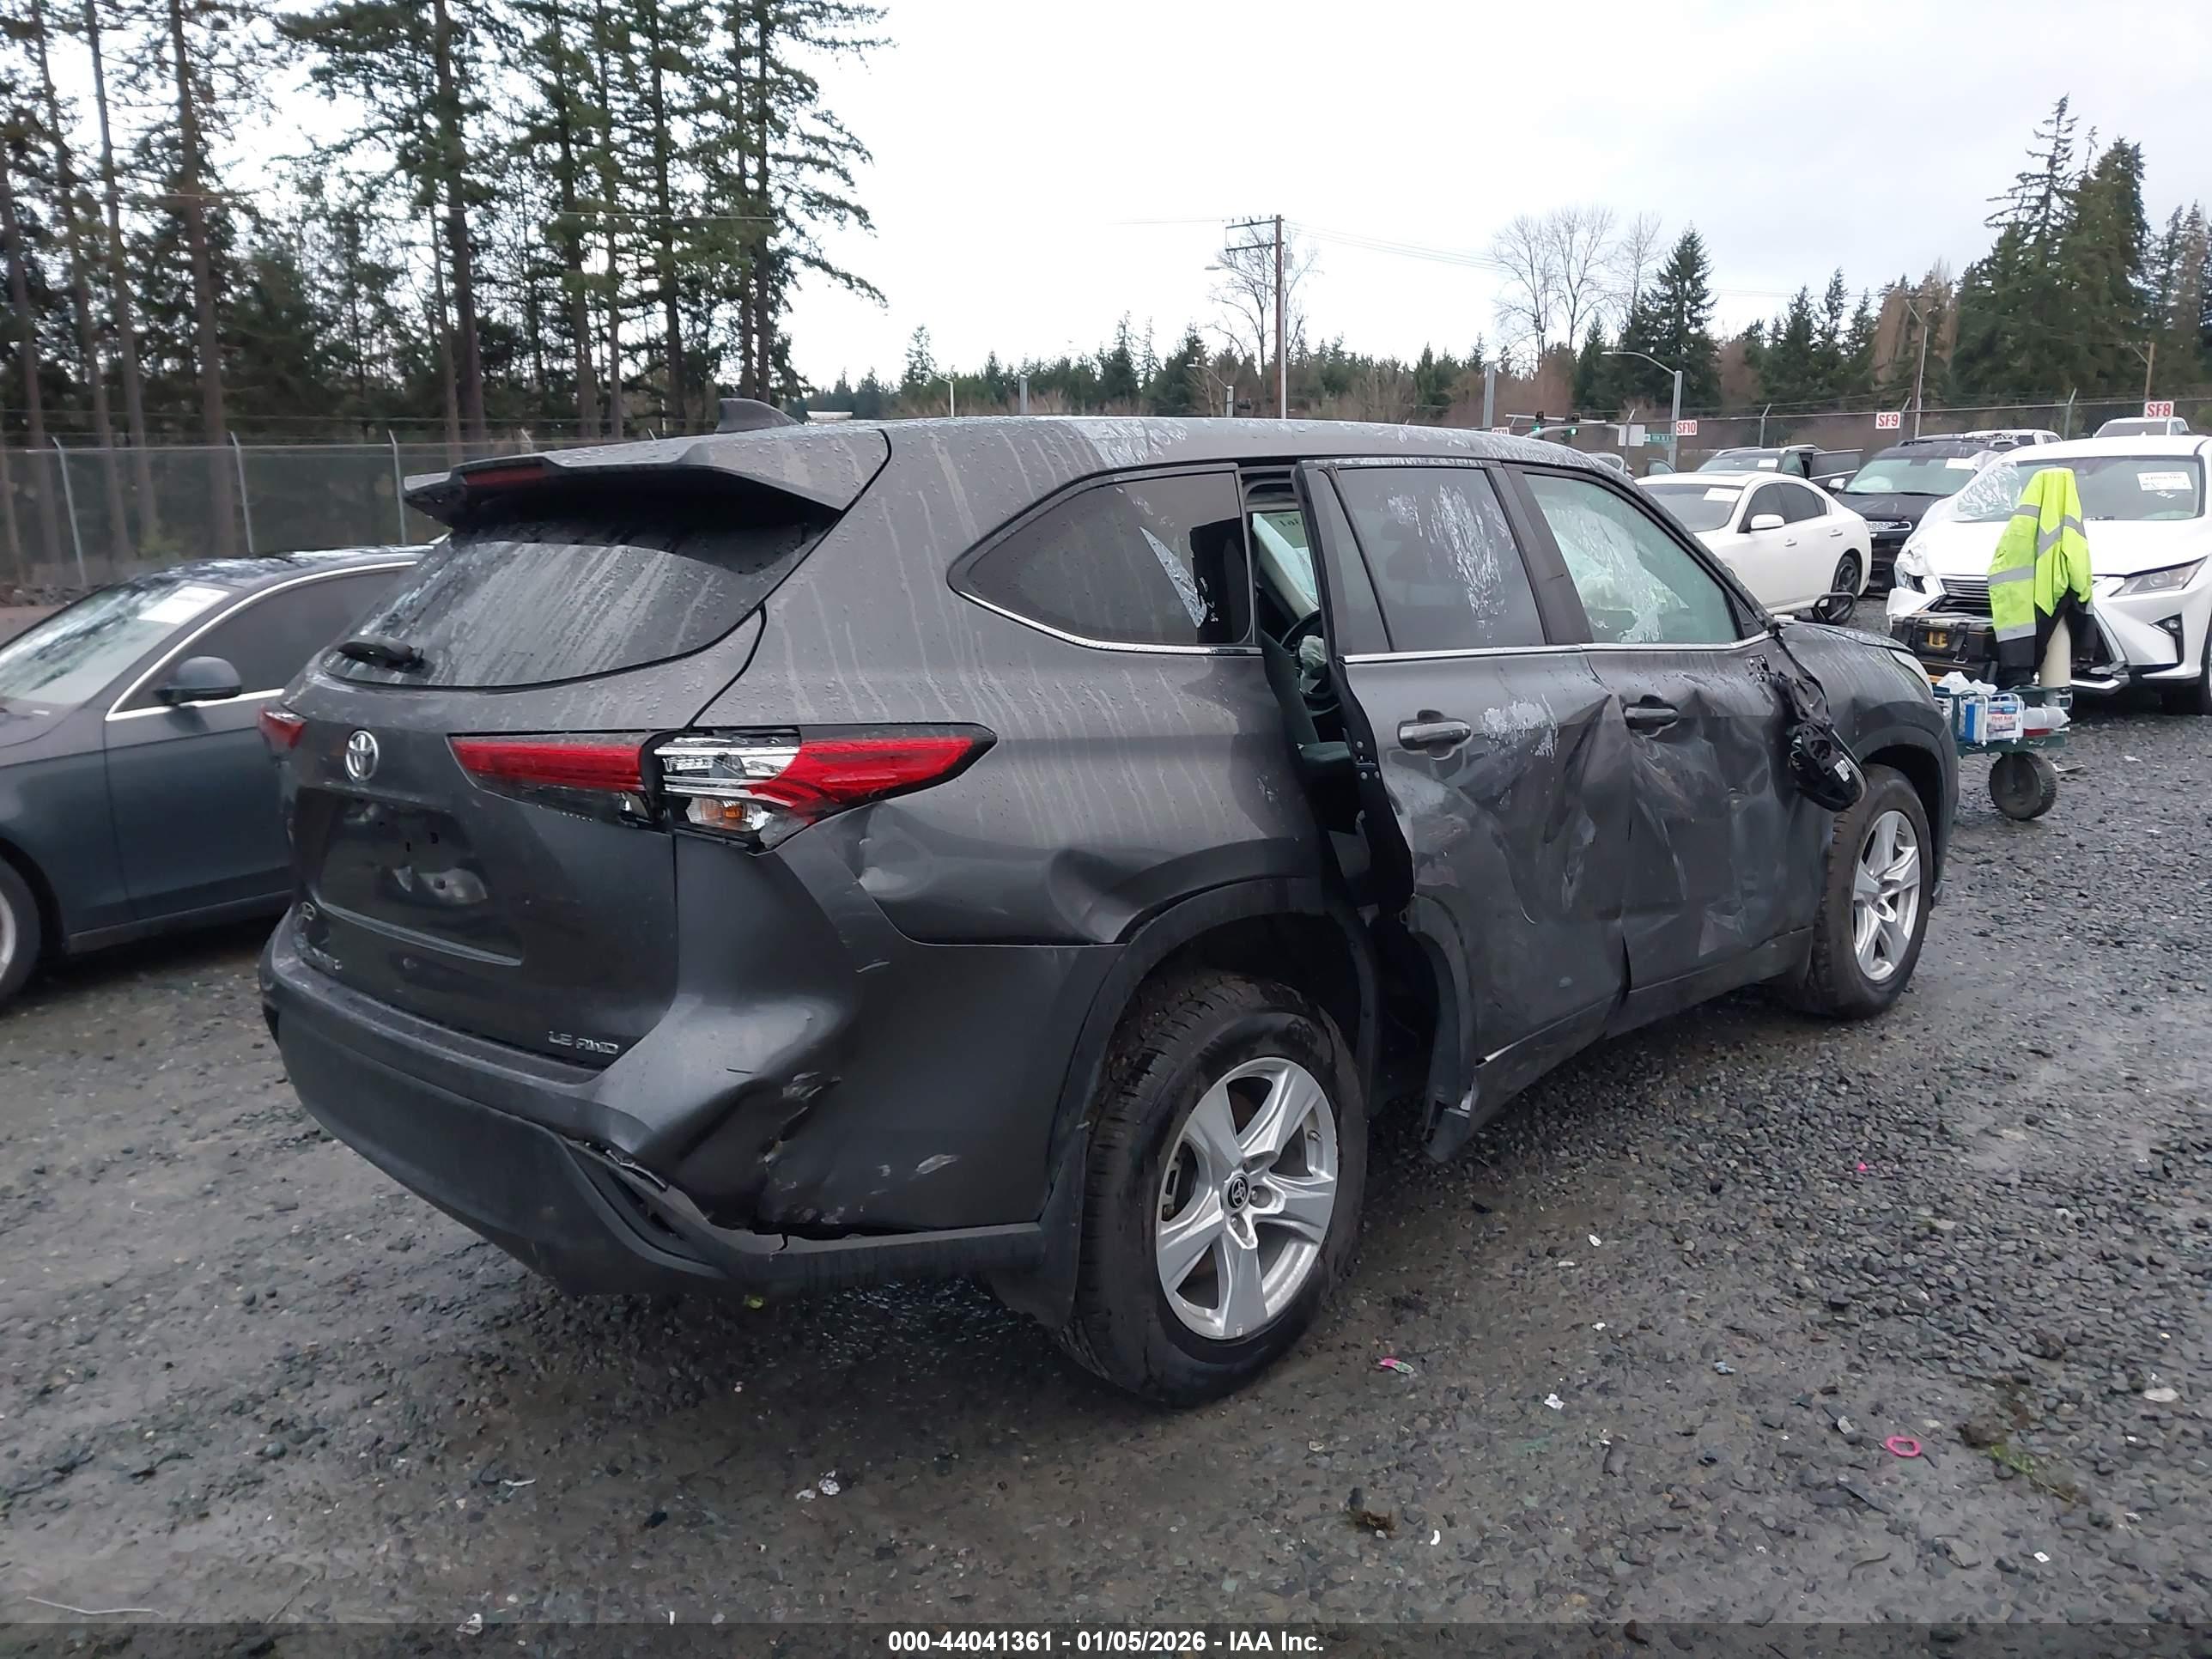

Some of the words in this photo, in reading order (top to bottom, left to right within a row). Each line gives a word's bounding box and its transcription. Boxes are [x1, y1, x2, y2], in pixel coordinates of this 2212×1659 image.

[2147, 404, 2172, 416] SF8
[1878, 414, 1899, 426] SF9
[1677, 422, 1696, 434] SF10
[548, 1030, 573, 1046] LE
[576, 1038, 619, 1055] AWD
